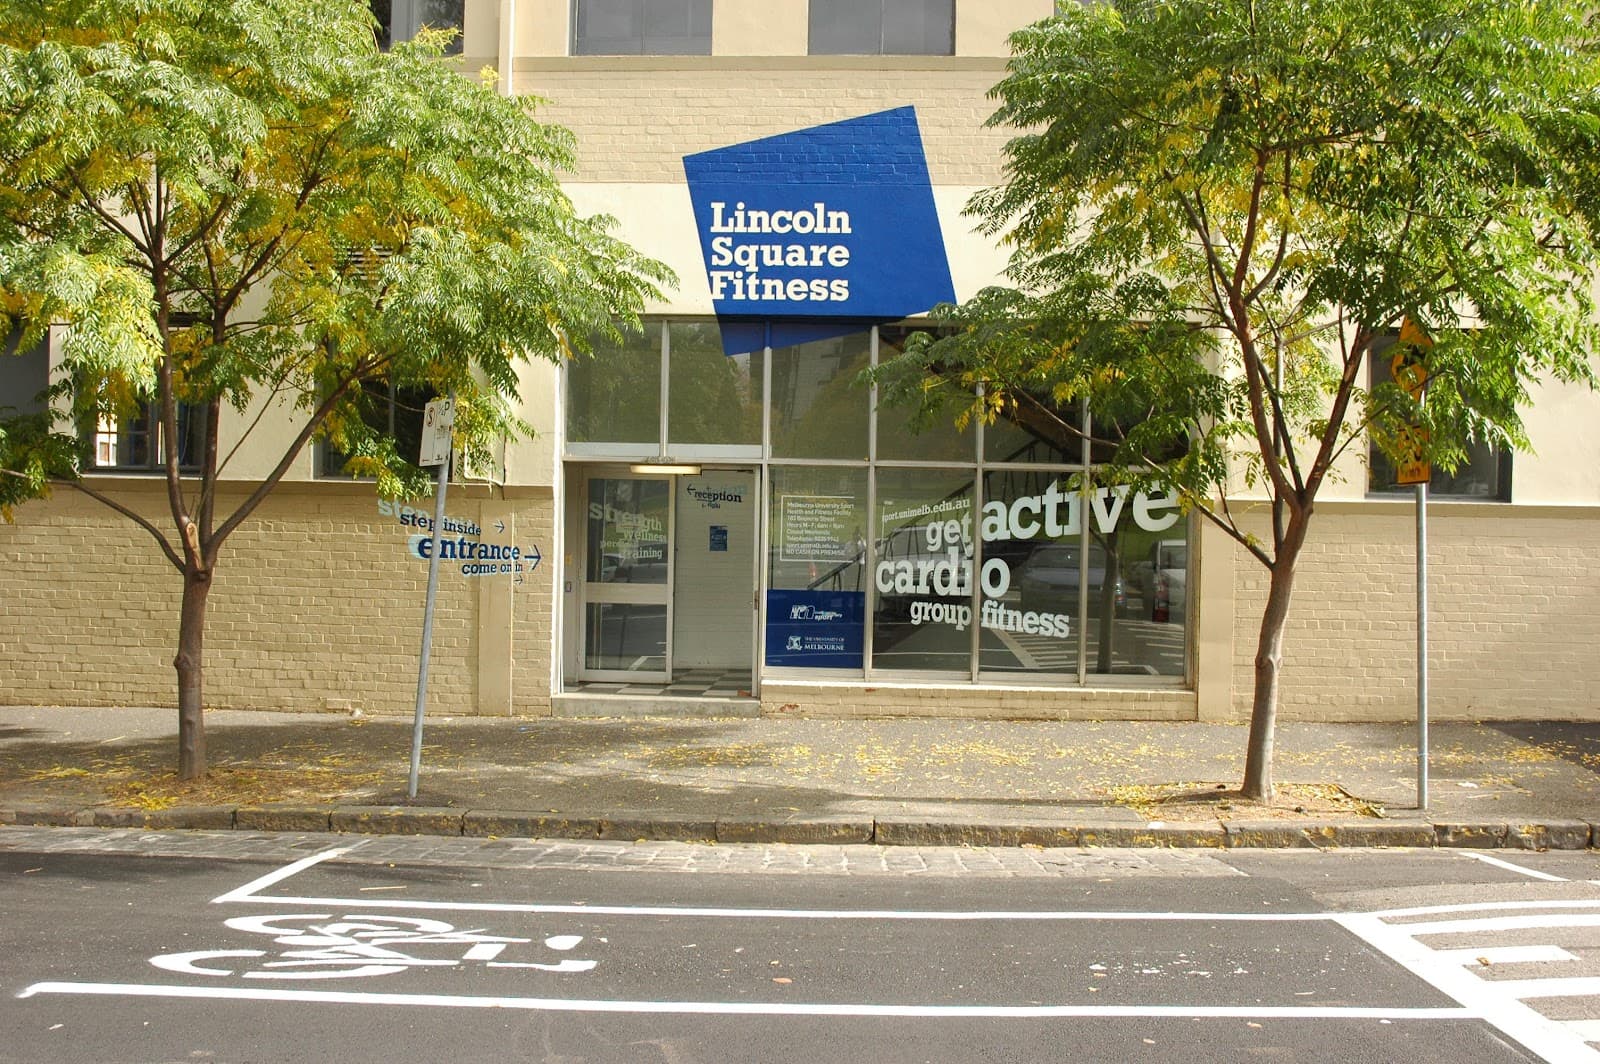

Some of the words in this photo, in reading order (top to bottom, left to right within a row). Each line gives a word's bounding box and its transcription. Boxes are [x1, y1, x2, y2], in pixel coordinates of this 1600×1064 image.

[710, 202, 852, 234] Lincoln
[711, 237, 850, 272] Square
[710, 271, 849, 301] Fitness
[695, 491, 742, 503] reception
[443, 518, 481, 536] inside
[926, 511, 972, 551] get
[981, 479, 1181, 541] active
[417, 537, 521, 560] entrance
[461, 562, 497, 575] come
[500, 563, 512, 573] on
[875, 546, 1010, 598] cardio
[910, 601, 972, 631] group
[981, 600, 1070, 638] fitness
